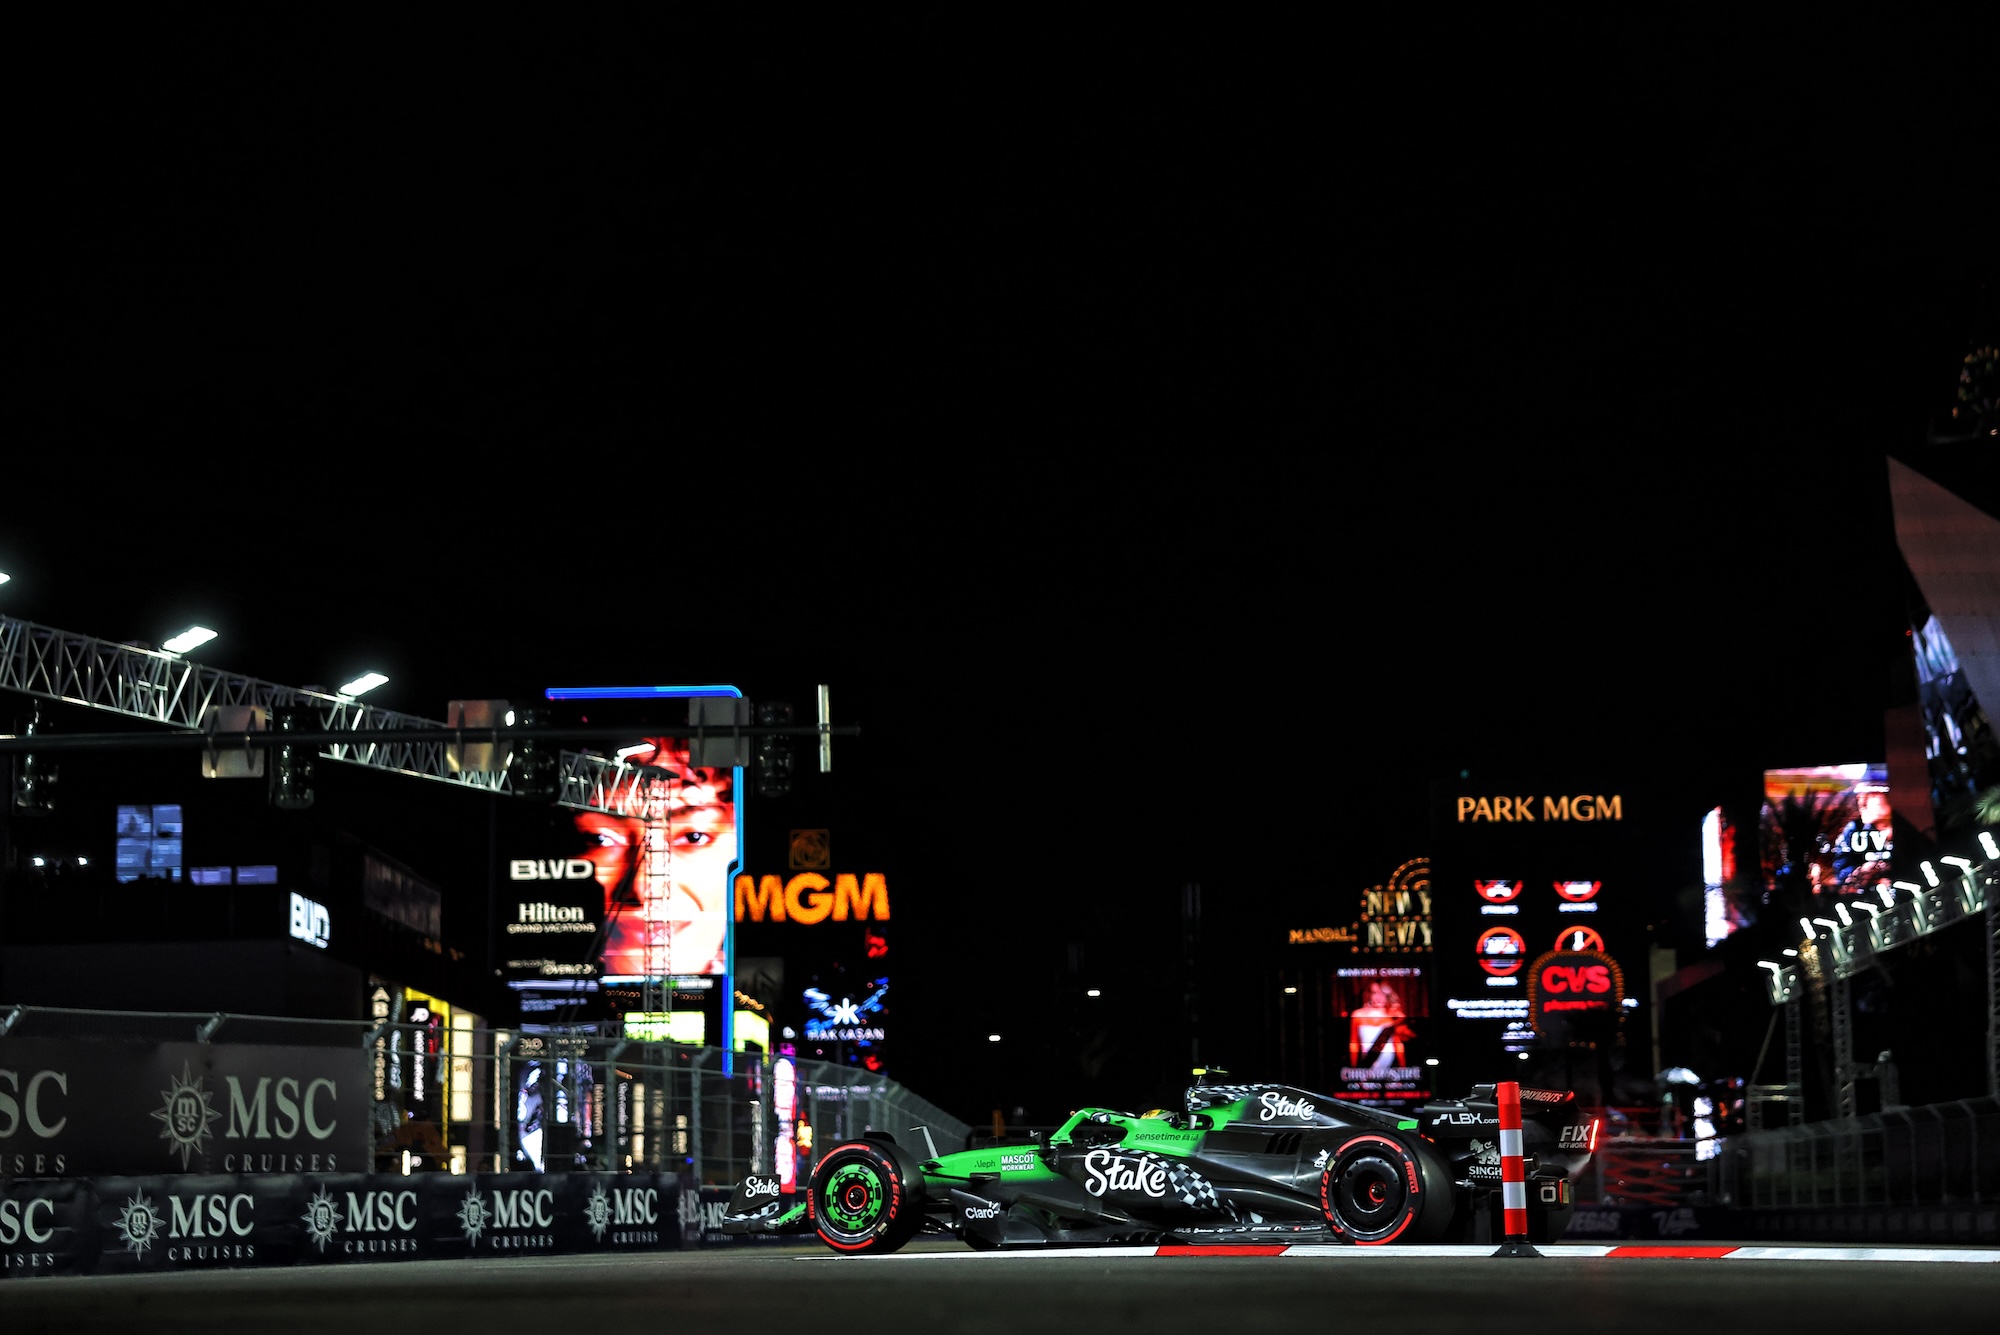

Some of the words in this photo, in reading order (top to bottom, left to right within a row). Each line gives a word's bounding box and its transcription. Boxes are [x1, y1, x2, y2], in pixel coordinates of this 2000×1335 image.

[1457, 796, 1535, 822] PARK
[1543, 794, 1622, 821] MGM
[509, 859, 594, 880] BLVD
[735, 872, 891, 925] MGM
[518, 902, 585, 923] Hilton
[1541, 965, 1612, 994] CVS
[0, 1068, 68, 1138] SC
[225, 1075, 337, 1140] MSC
[1258, 1091, 1316, 1121] Stake
[1134, 1131, 1181, 1141] sensetime
[1560, 1125, 1590, 1142] FIX
[224, 1153, 337, 1172] CRUISES
[1001, 1153, 1035, 1164] MASCOT
[1468, 1166, 1502, 1175] SINGH
[1084, 1149, 1167, 1198] Stake
[745, 1176, 780, 1198] Stake
[167, 1195, 254, 1238] MSC
[345, 1191, 417, 1232] MSC
[492, 1189, 553, 1228] MSC
[614, 1188, 658, 1225] MSC
[965, 1206, 994, 1219] Claro
[0, 1199, 54, 1245] SC
[167, 1244, 254, 1261] CRUISES
[343, 1238, 417, 1253] CRUISES
[4, 1253, 54, 1267] ISES
